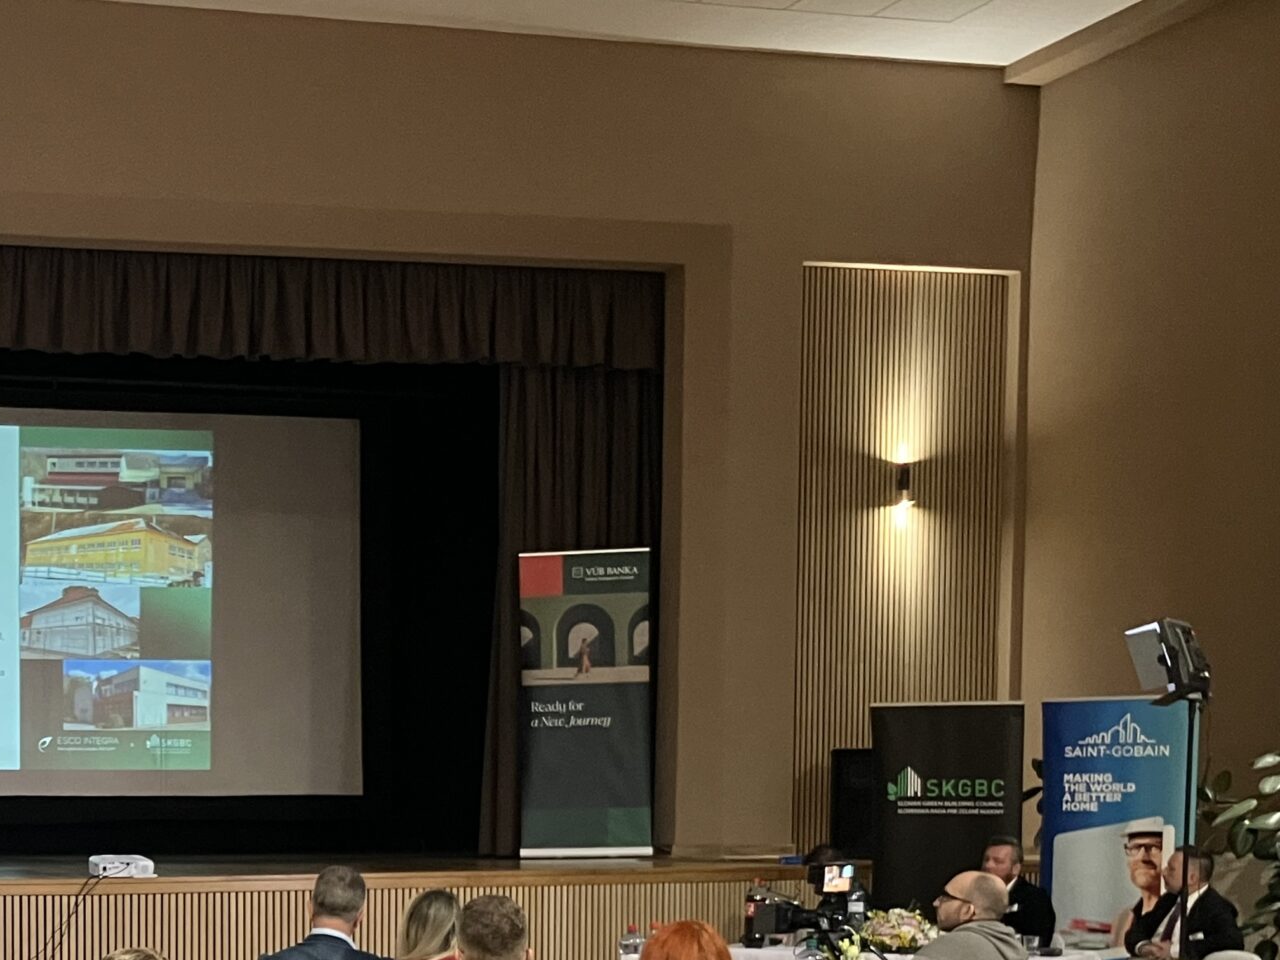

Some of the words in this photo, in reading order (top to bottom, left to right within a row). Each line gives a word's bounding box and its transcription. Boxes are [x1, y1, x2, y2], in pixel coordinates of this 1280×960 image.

[607, 566, 639, 576] BANKA
[531, 700, 566, 713] Ready
[568, 699, 584, 711] for
[531, 719, 538, 728] a
[565, 715, 612, 729] Journey
[1064, 744, 1170, 758] SAINT-GOBAIN
[1063, 772, 1112, 783] MAKING
[926, 778, 1005, 798] SKGBC
[1064, 782, 1086, 793] THE
[1090, 782, 1136, 793] WORLD
[1063, 792, 1071, 802] A
[1074, 792, 1122, 803] BETTER
[1062, 802, 1099, 812] HOME
